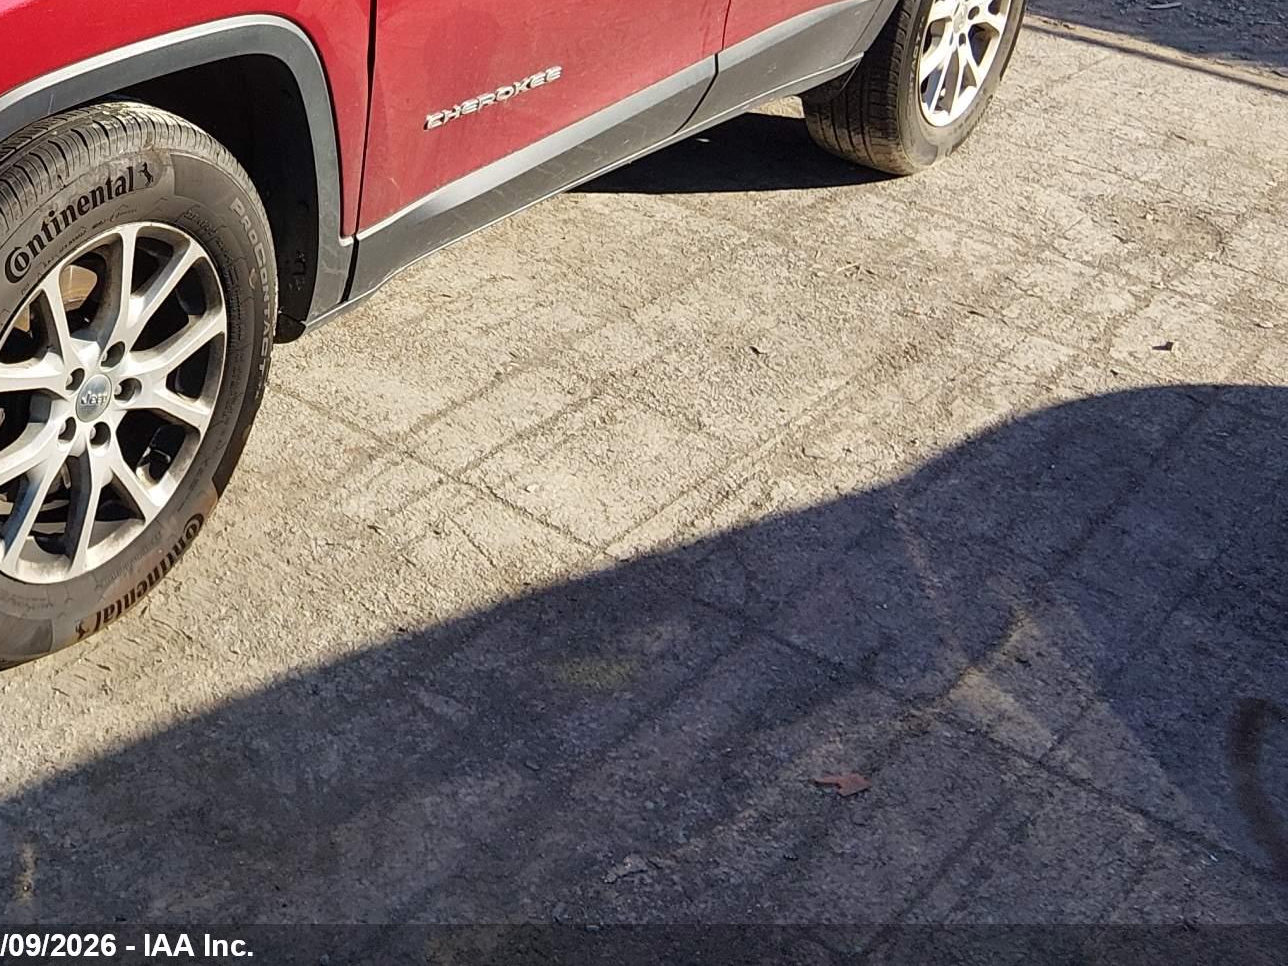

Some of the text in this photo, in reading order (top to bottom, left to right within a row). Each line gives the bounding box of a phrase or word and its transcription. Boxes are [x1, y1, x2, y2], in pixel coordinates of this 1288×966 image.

[423, 65, 563, 131] CHEROKEE
[4, 166, 134, 284] Continental
[92, 513, 205, 632] Continental
